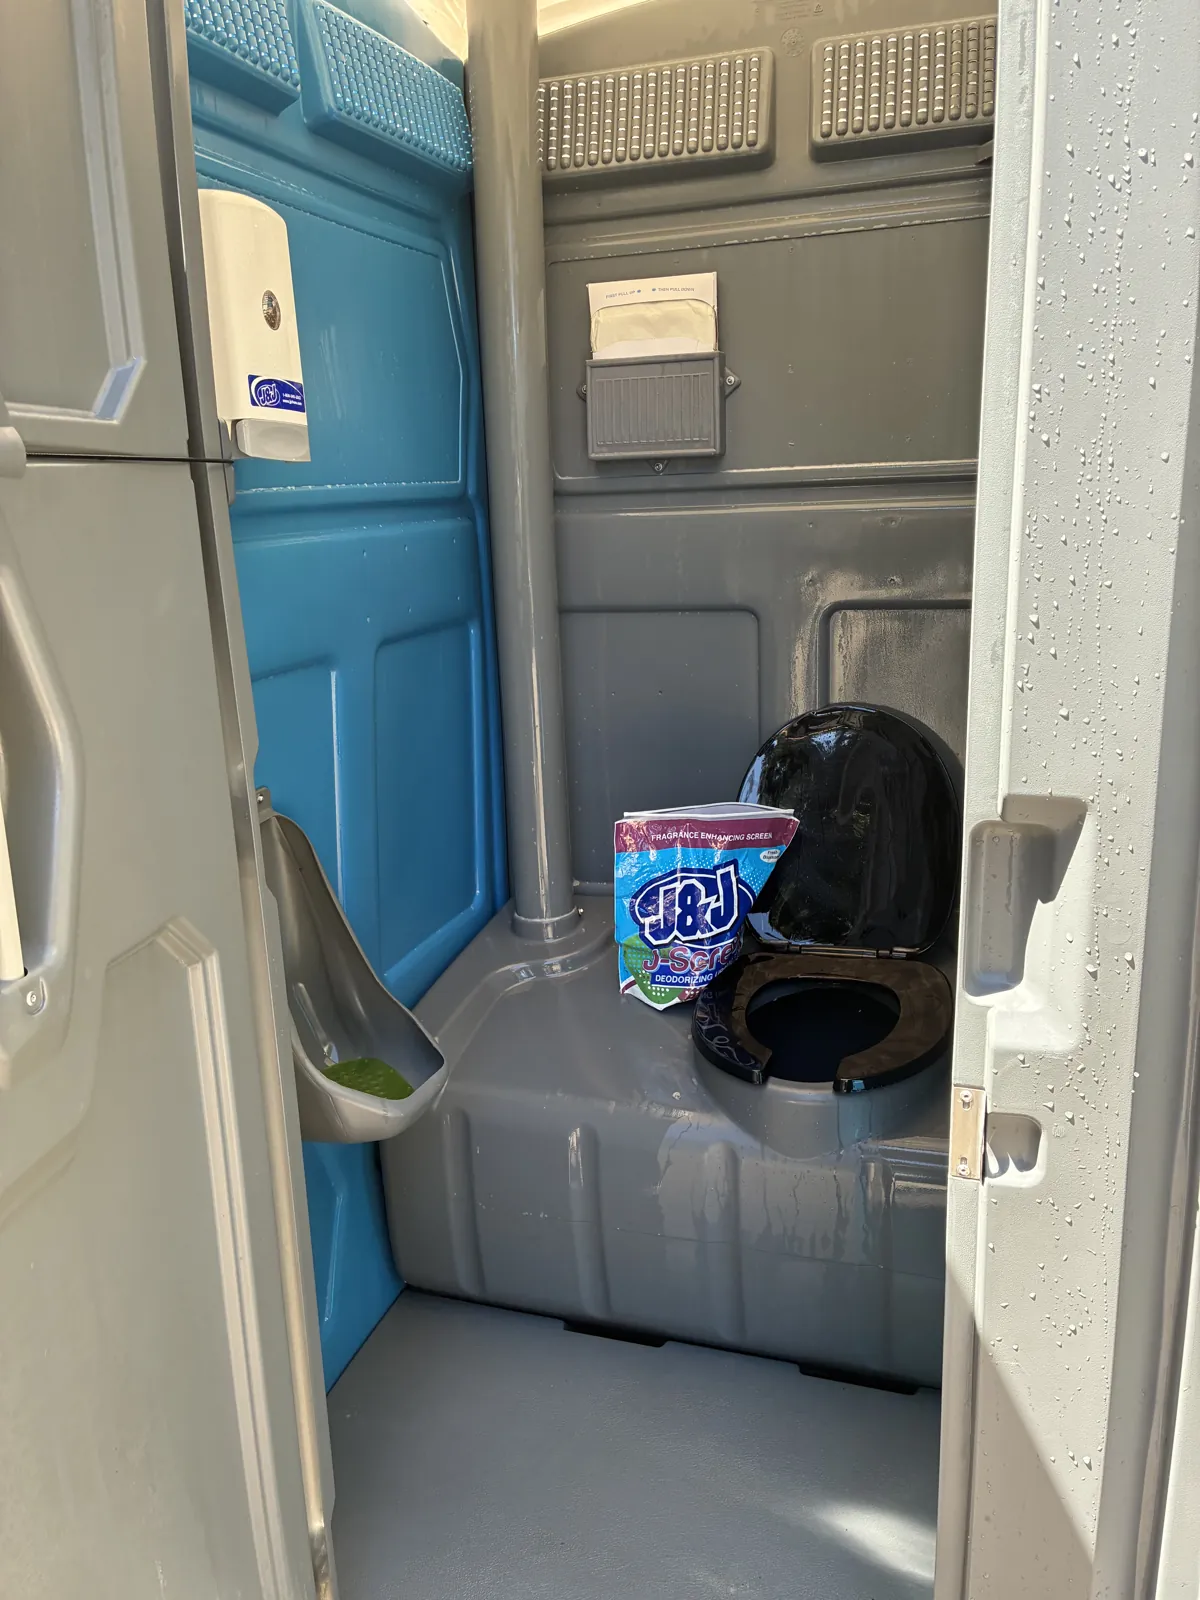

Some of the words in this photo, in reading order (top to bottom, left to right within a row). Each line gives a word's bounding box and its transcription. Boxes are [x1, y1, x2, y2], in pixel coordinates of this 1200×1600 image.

[259, 383, 278, 406] J&J
[651, 831, 699, 841] FRAGRANCE
[700, 832, 744, 842] ENHANCING
[746, 832, 773, 841] SCREEN
[641, 864, 738, 945] J&J
[655, 973, 713, 984] DEODORIZING
